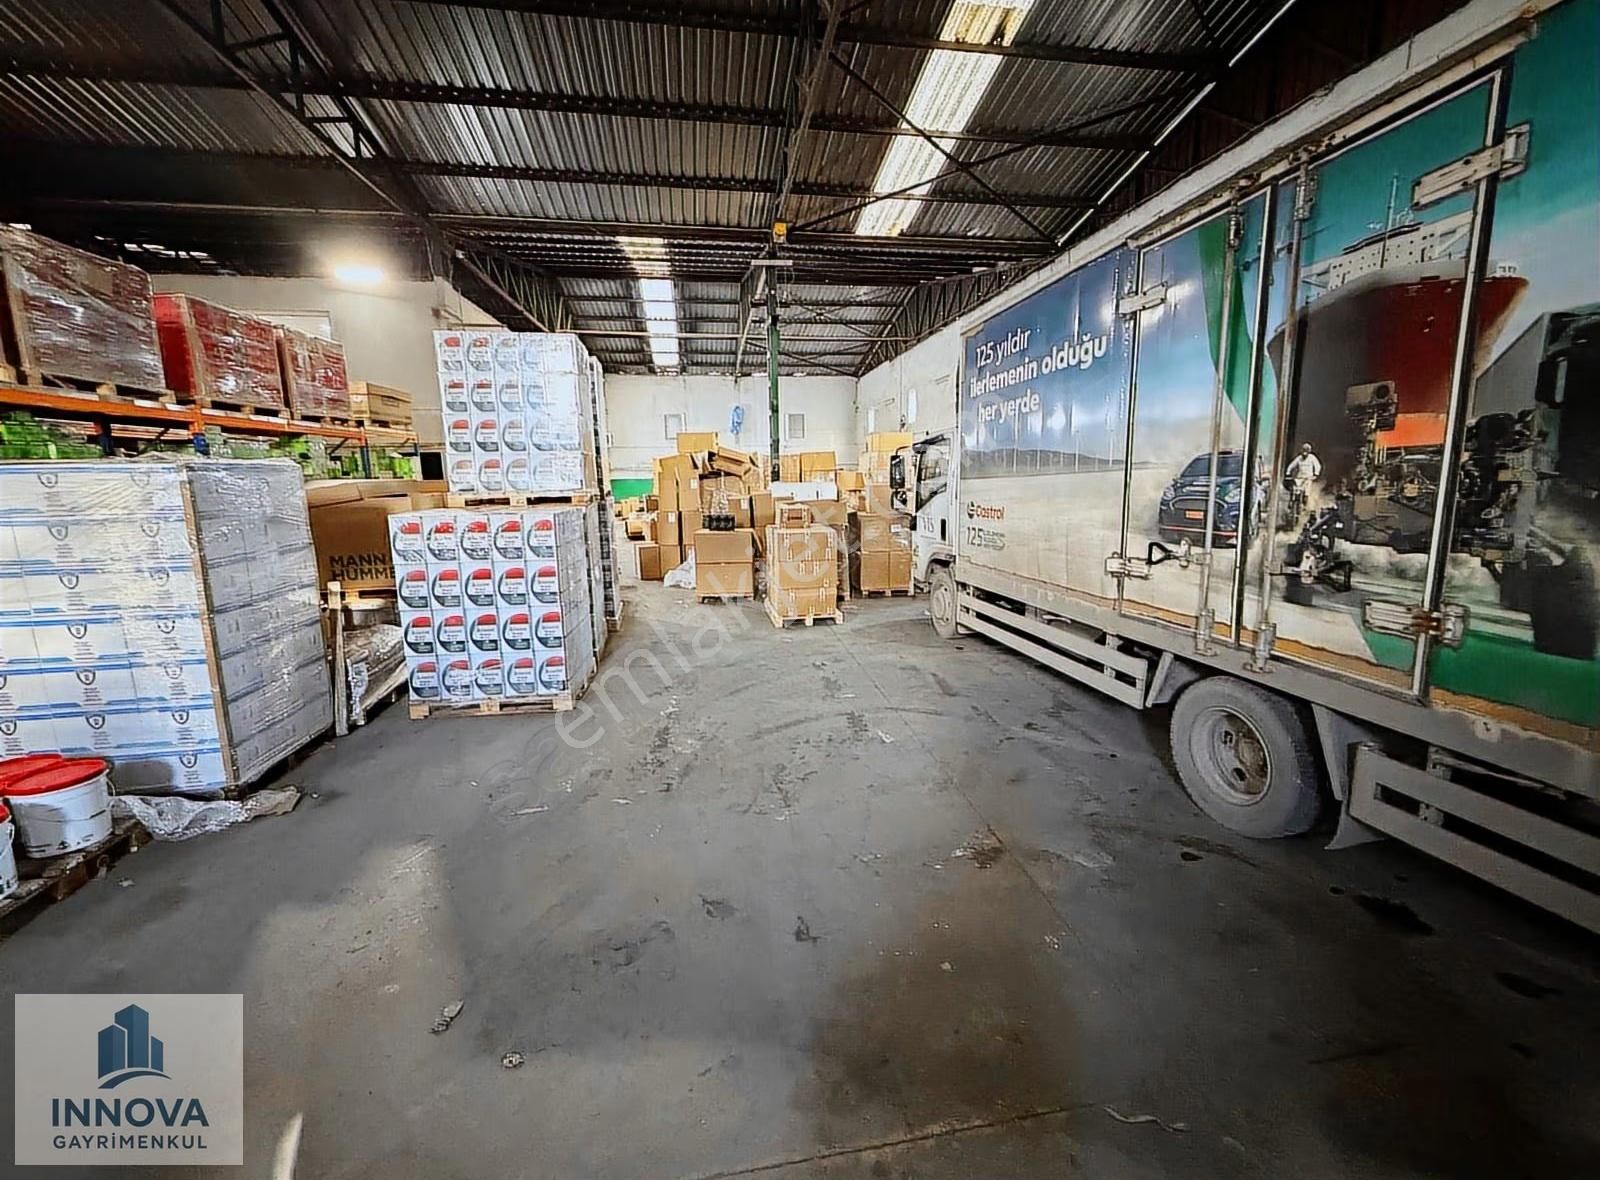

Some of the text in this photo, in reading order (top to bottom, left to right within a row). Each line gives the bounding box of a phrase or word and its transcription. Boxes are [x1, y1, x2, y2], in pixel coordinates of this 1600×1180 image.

[970, 333, 1107, 398] ilerlemenin olduğu
[976, 342, 994, 369] 125
[978, 388, 1040, 424] her yerde
[976, 504, 1004, 520] Castrol
[967, 526, 983, 547] 125
[329, 553, 387, 568] MANN
